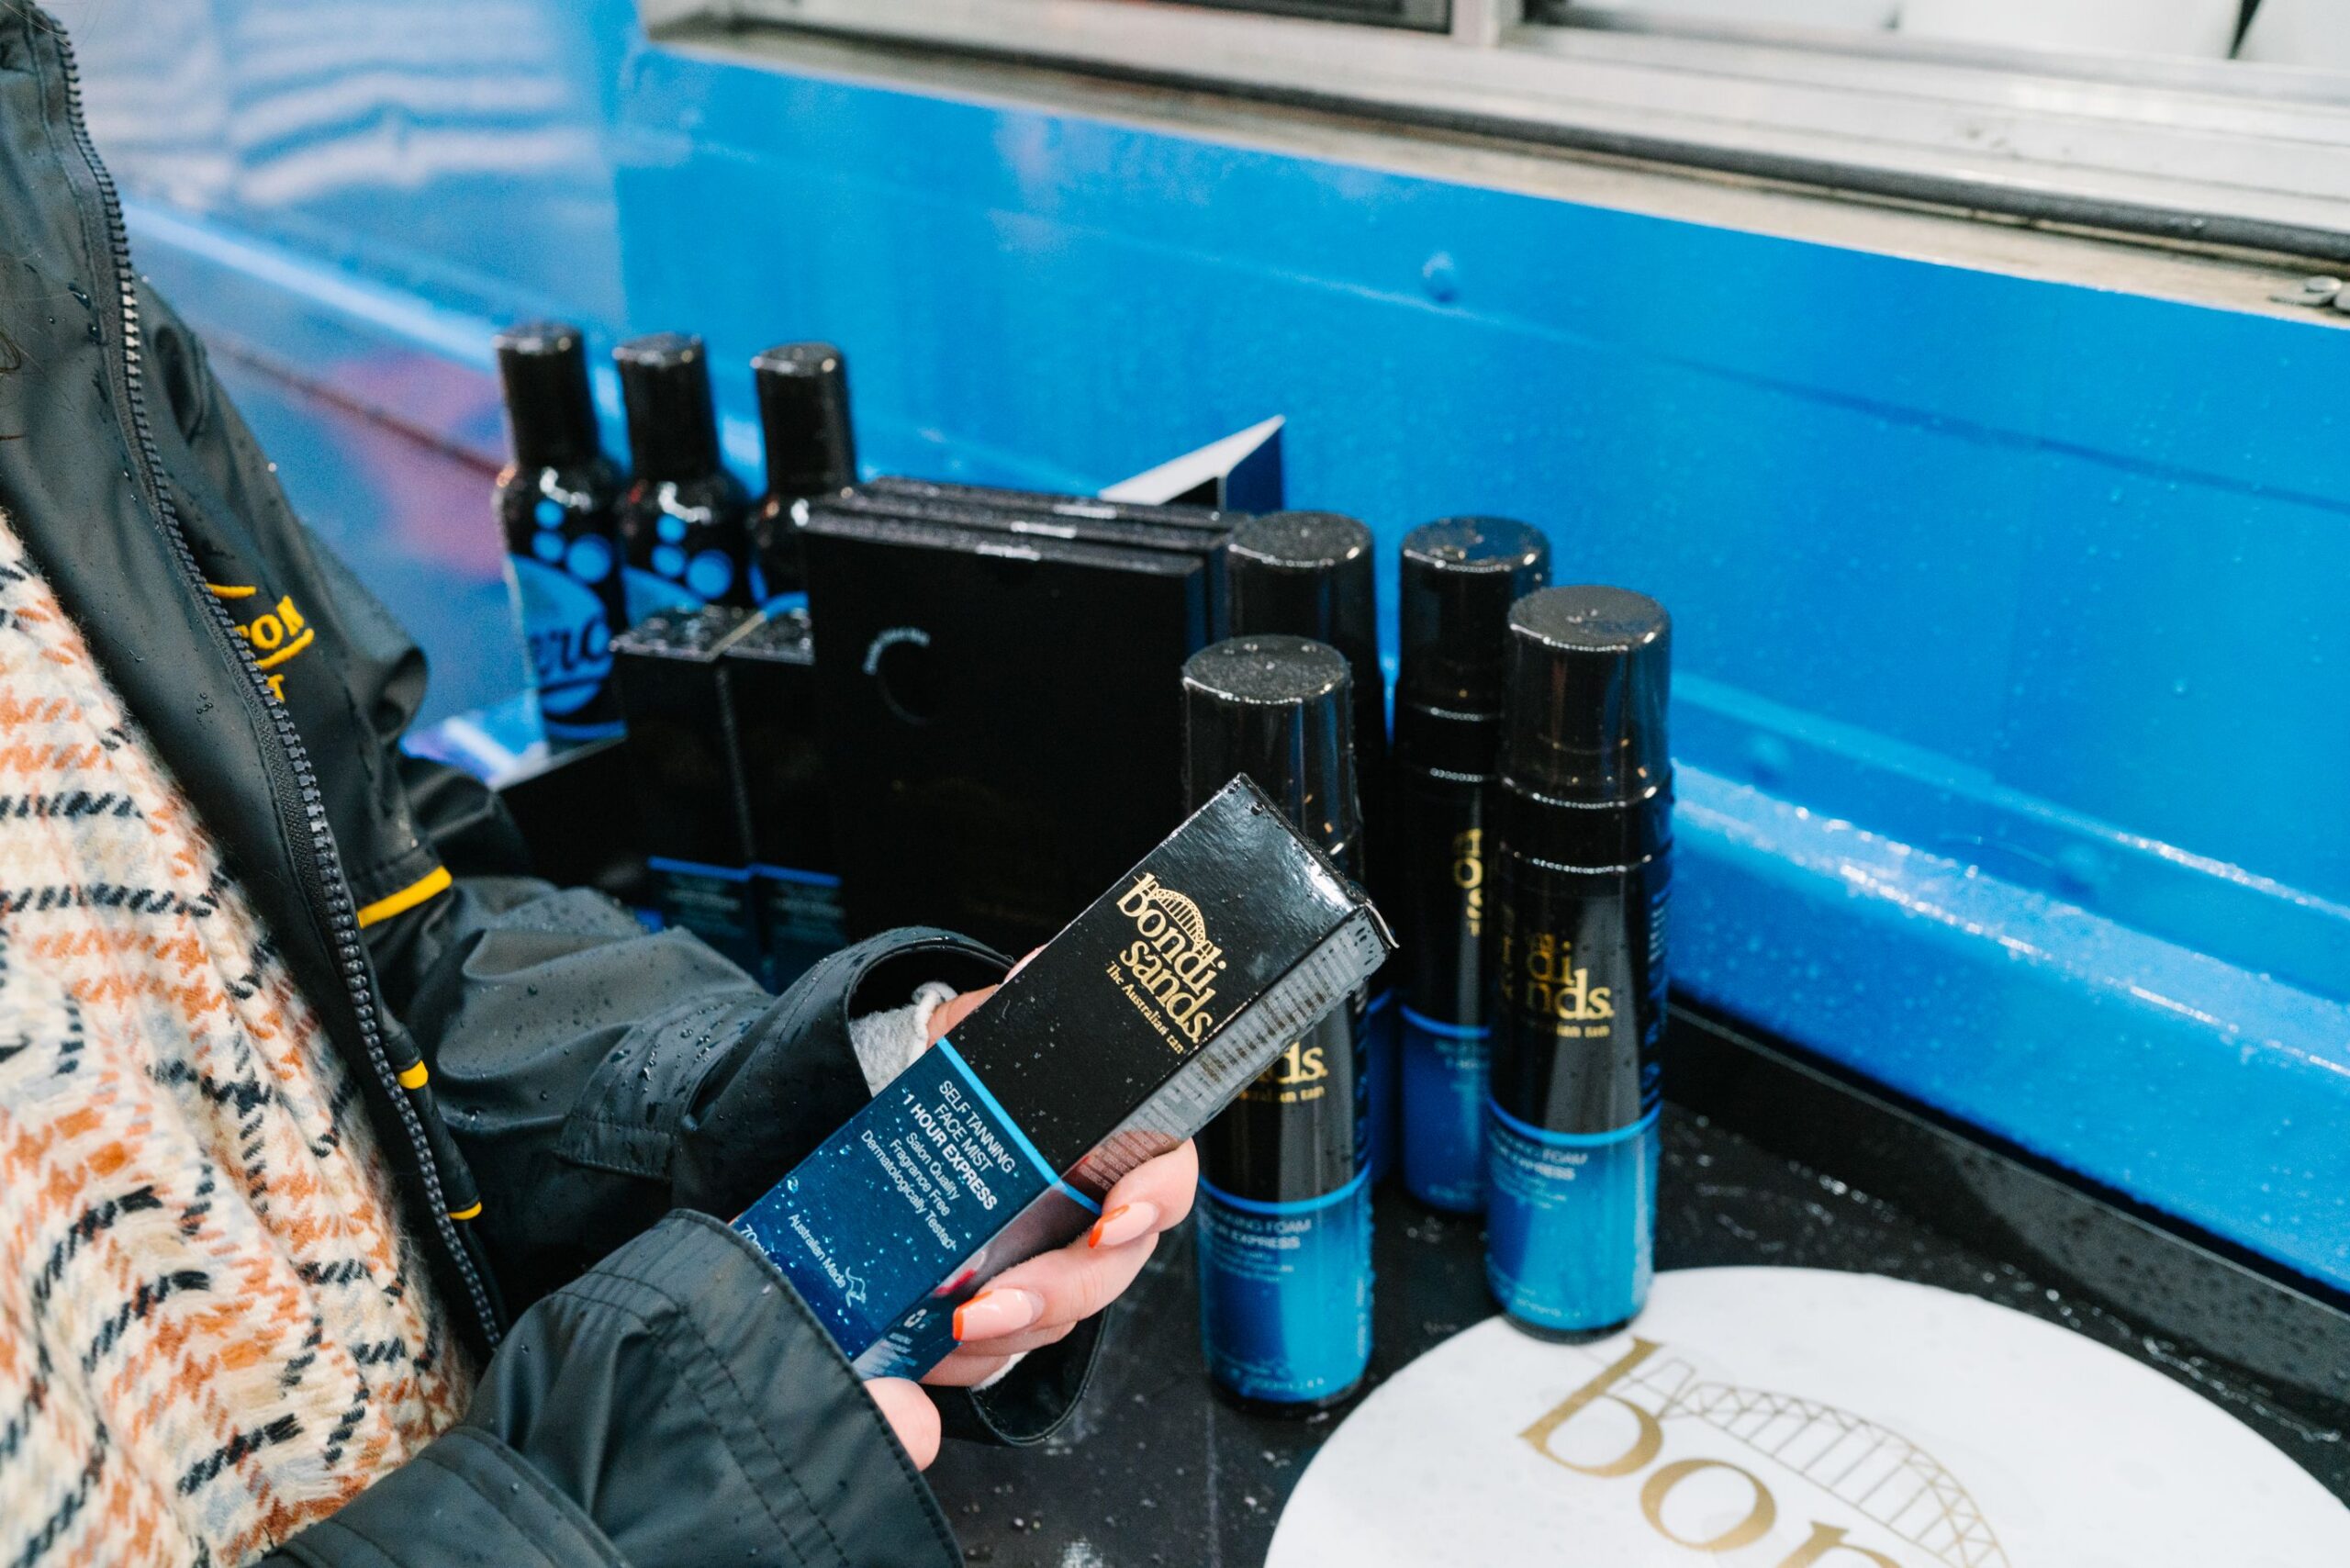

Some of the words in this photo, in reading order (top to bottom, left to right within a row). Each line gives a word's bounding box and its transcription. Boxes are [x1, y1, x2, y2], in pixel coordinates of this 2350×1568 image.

[1116, 872, 1226, 995] bondi
[1106, 960, 1125, 986] The
[1122, 983, 1169, 1036] Australian
[1166, 1034, 1184, 1055] tan
[902, 1093, 915, 1106] 1
[910, 1103, 948, 1148] HOUR
[942, 1143, 999, 1211] EXPRESS
[905, 1132, 933, 1165] Salon
[929, 1160, 961, 1202] Quality
[934, 1103, 968, 1142] FACE
[961, 1137, 994, 1171] MIST
[939, 1080, 971, 1114] SELF
[966, 1111, 1016, 1174] TANNING
[860, 1129, 928, 1215] Dermatologically
[924, 1210, 957, 1250] Tested
[889, 1138, 933, 1193] Fragrance
[928, 1189, 951, 1217] Free
[788, 1213, 827, 1261] Australian
[822, 1257, 847, 1289] Made
